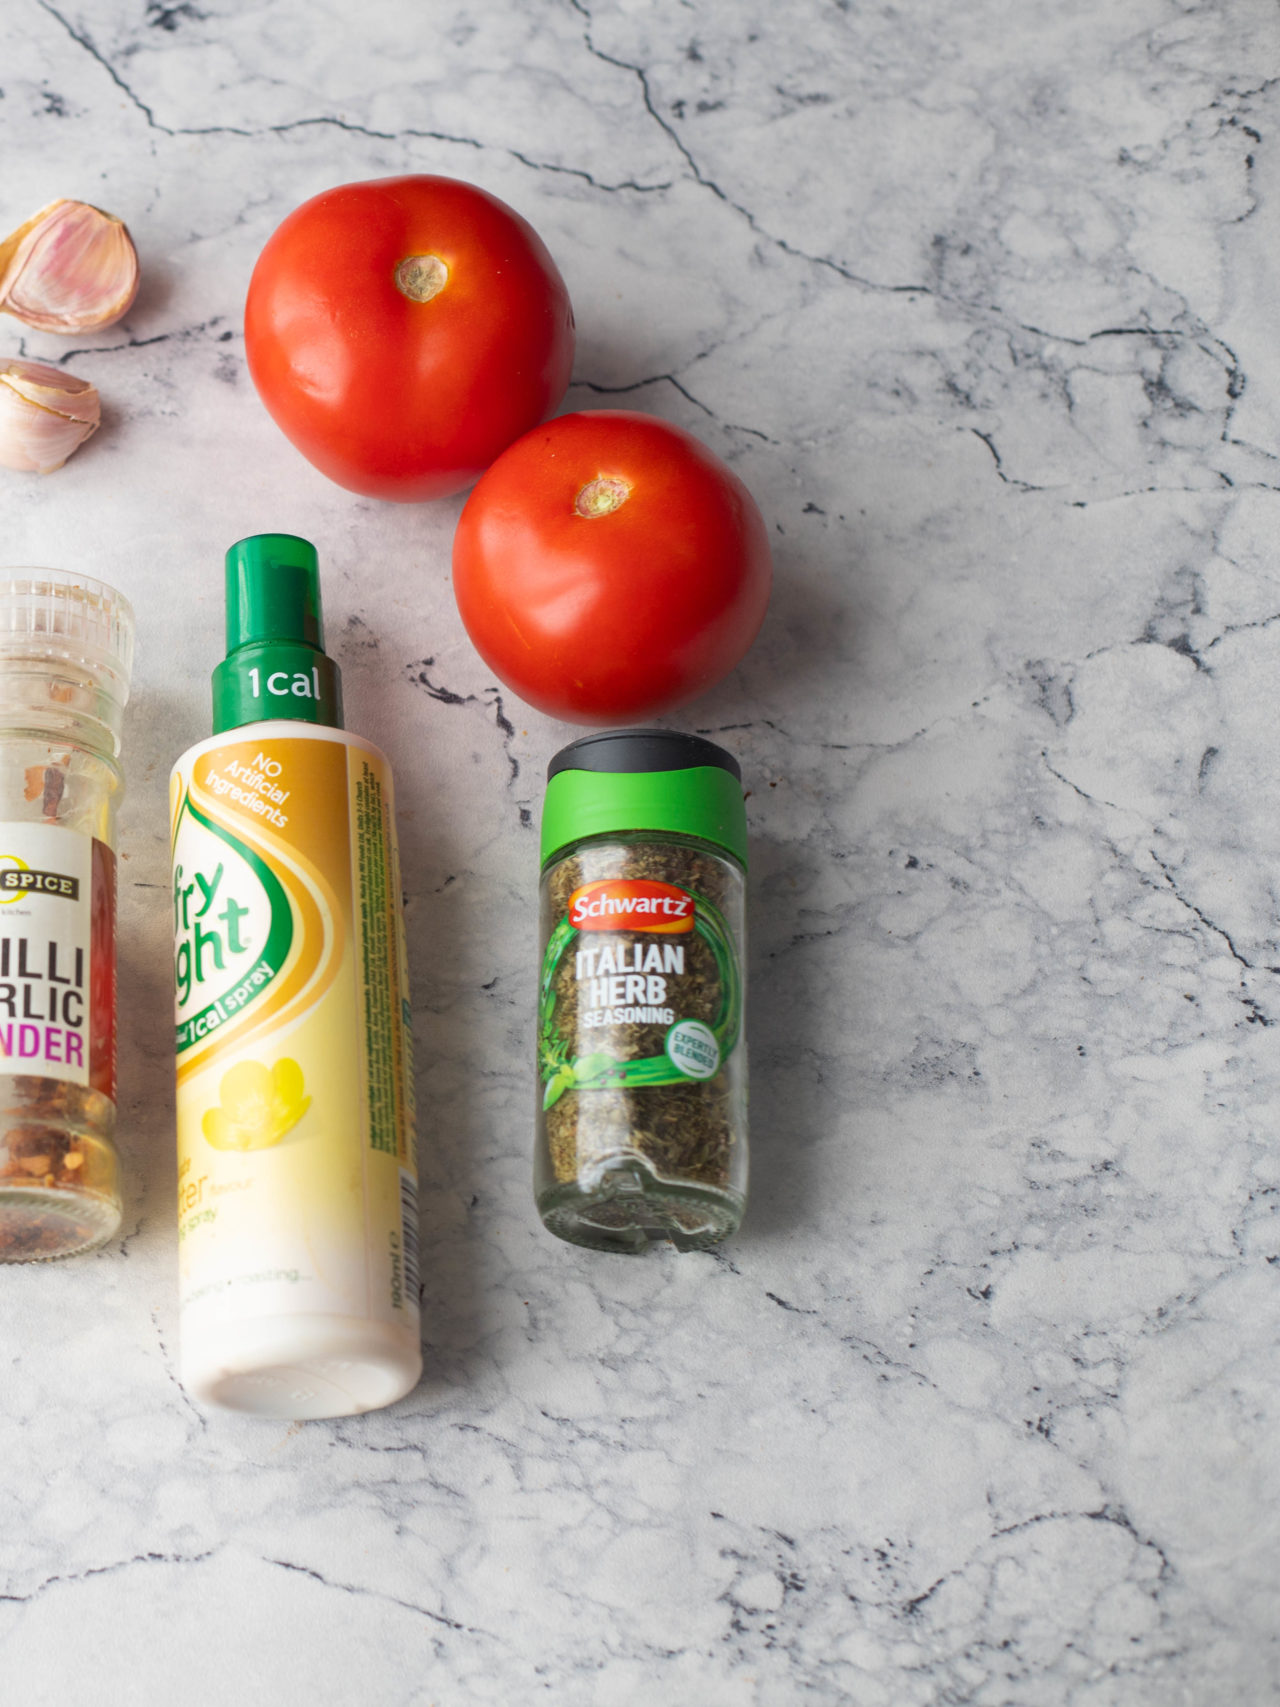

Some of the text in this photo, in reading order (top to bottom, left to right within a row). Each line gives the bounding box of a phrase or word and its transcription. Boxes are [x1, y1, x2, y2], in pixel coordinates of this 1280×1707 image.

[251, 752, 283, 778] NO
[224, 759, 290, 805] Artificial
[205, 769, 289, 828] Ingredients
[5, 872, 73, 894] SPICE
[573, 894, 687, 922] Schwartz
[576, 944, 684, 980] ITALIAN
[590, 975, 667, 1008] HERB
[584, 1007, 675, 1028] SEASONING
[674, 1043, 714, 1069] BLENDED
